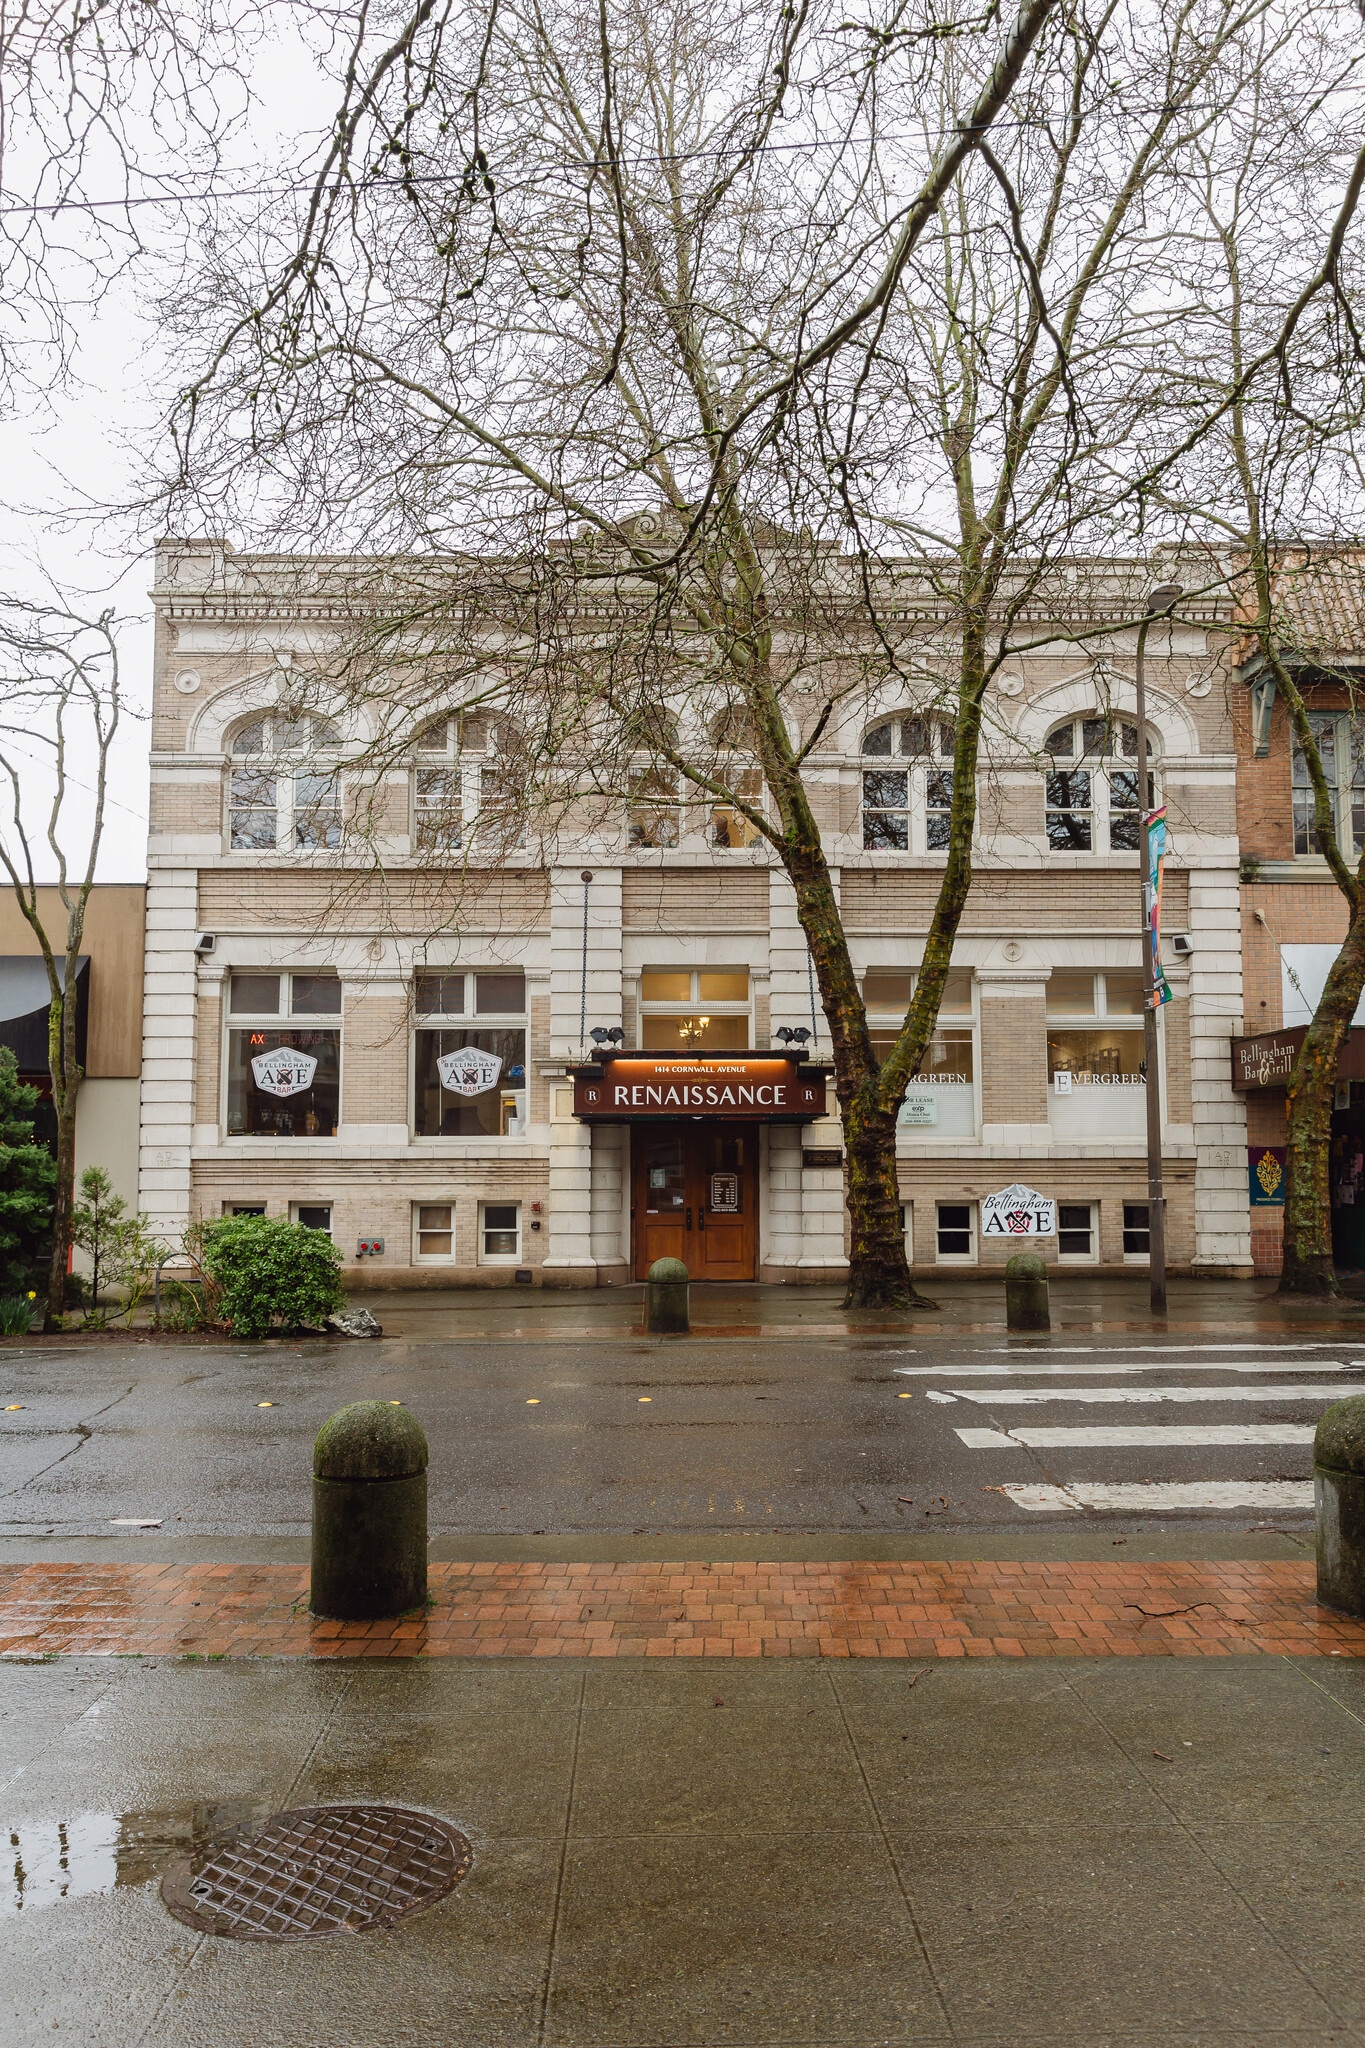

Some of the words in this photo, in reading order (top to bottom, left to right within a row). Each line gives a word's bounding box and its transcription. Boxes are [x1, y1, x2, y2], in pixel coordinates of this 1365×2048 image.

[1240, 1040, 1295, 1064] Bellingham
[1244, 1065, 1260, 1080] Bar
[276, 1086, 292, 1094] BAR
[588, 1090, 597, 1101] R
[614, 1085, 787, 1106] RENAISSANCE
[804, 1090, 814, 1101] R
[984, 1194, 1053, 1212] Bellingham
